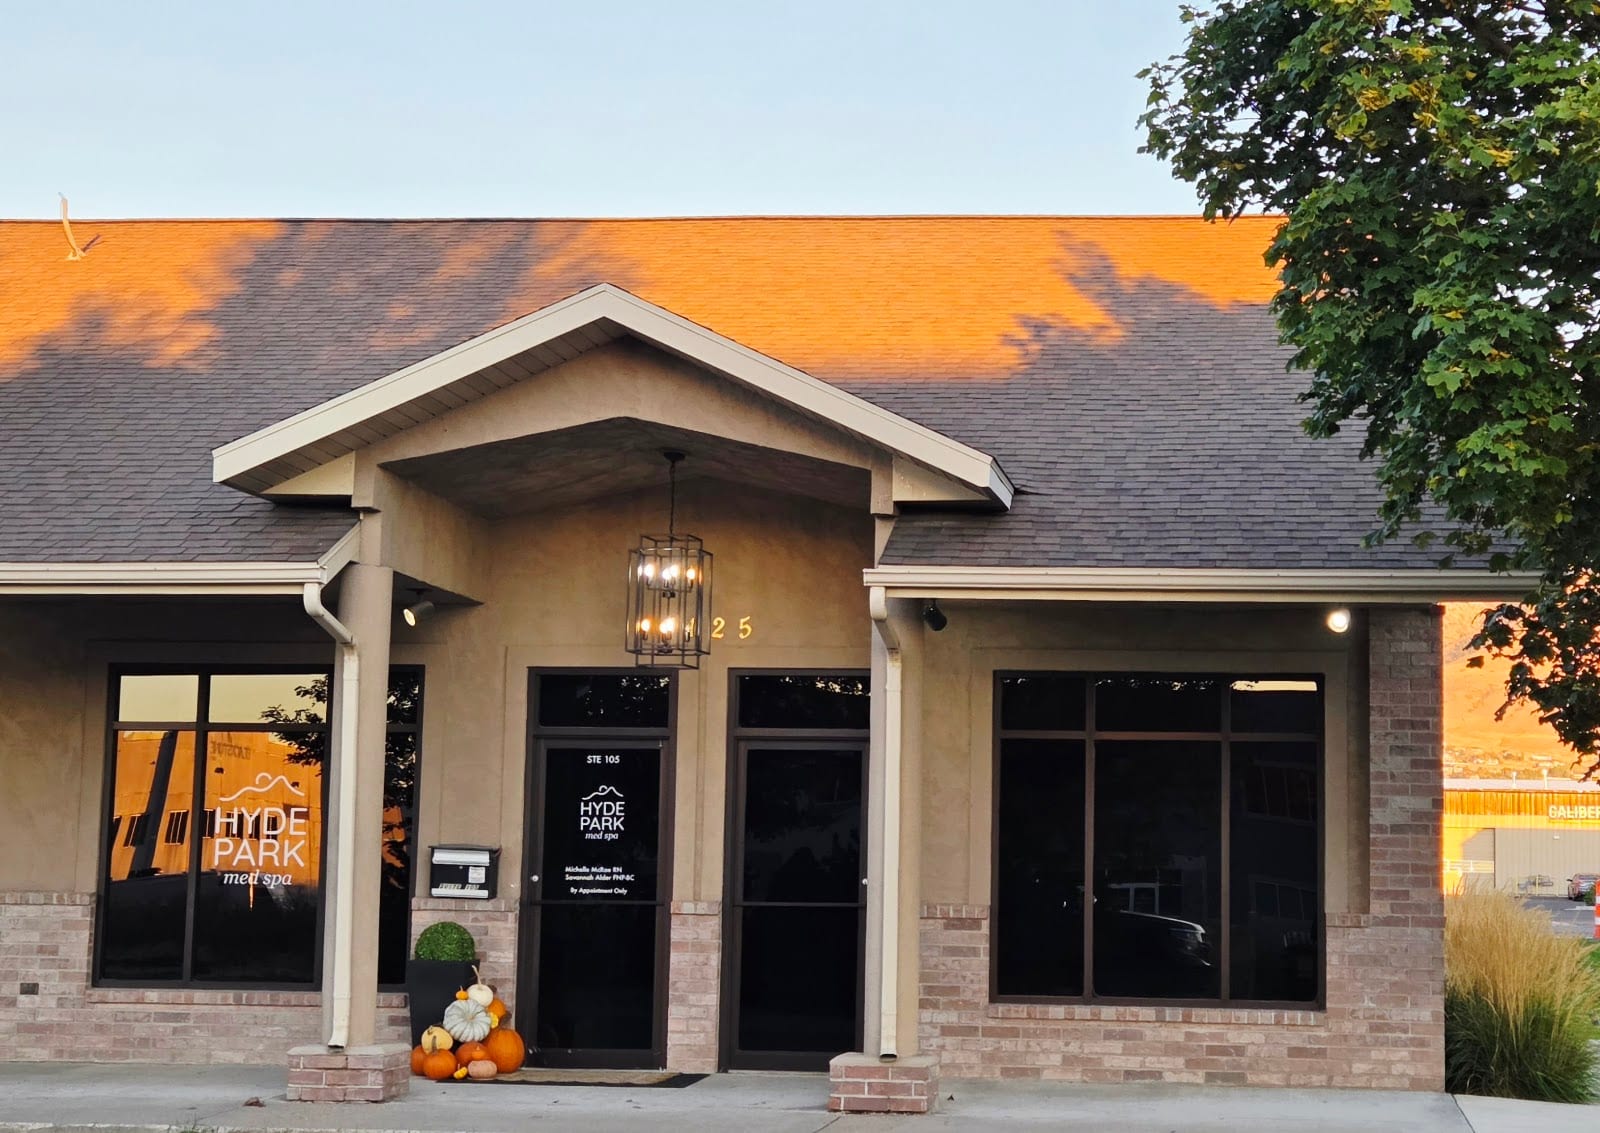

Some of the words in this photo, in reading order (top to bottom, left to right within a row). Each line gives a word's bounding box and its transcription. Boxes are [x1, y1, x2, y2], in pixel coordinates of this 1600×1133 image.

[586, 755, 602, 764] STE
[604, 755, 620, 764] 105
[580, 801, 625, 816] HYDE
[214, 806, 308, 835] HYDE
[580, 816, 625, 831] PARK
[585, 831, 603, 840] med
[604, 833, 618, 841] spa
[214, 839, 305, 868] PARK
[223, 869, 260, 885] med
[262, 873, 292, 889] spa
[570, 887, 578, 895] By
[578, 887, 613, 895] Appointment
[613, 887, 628, 896] Only
